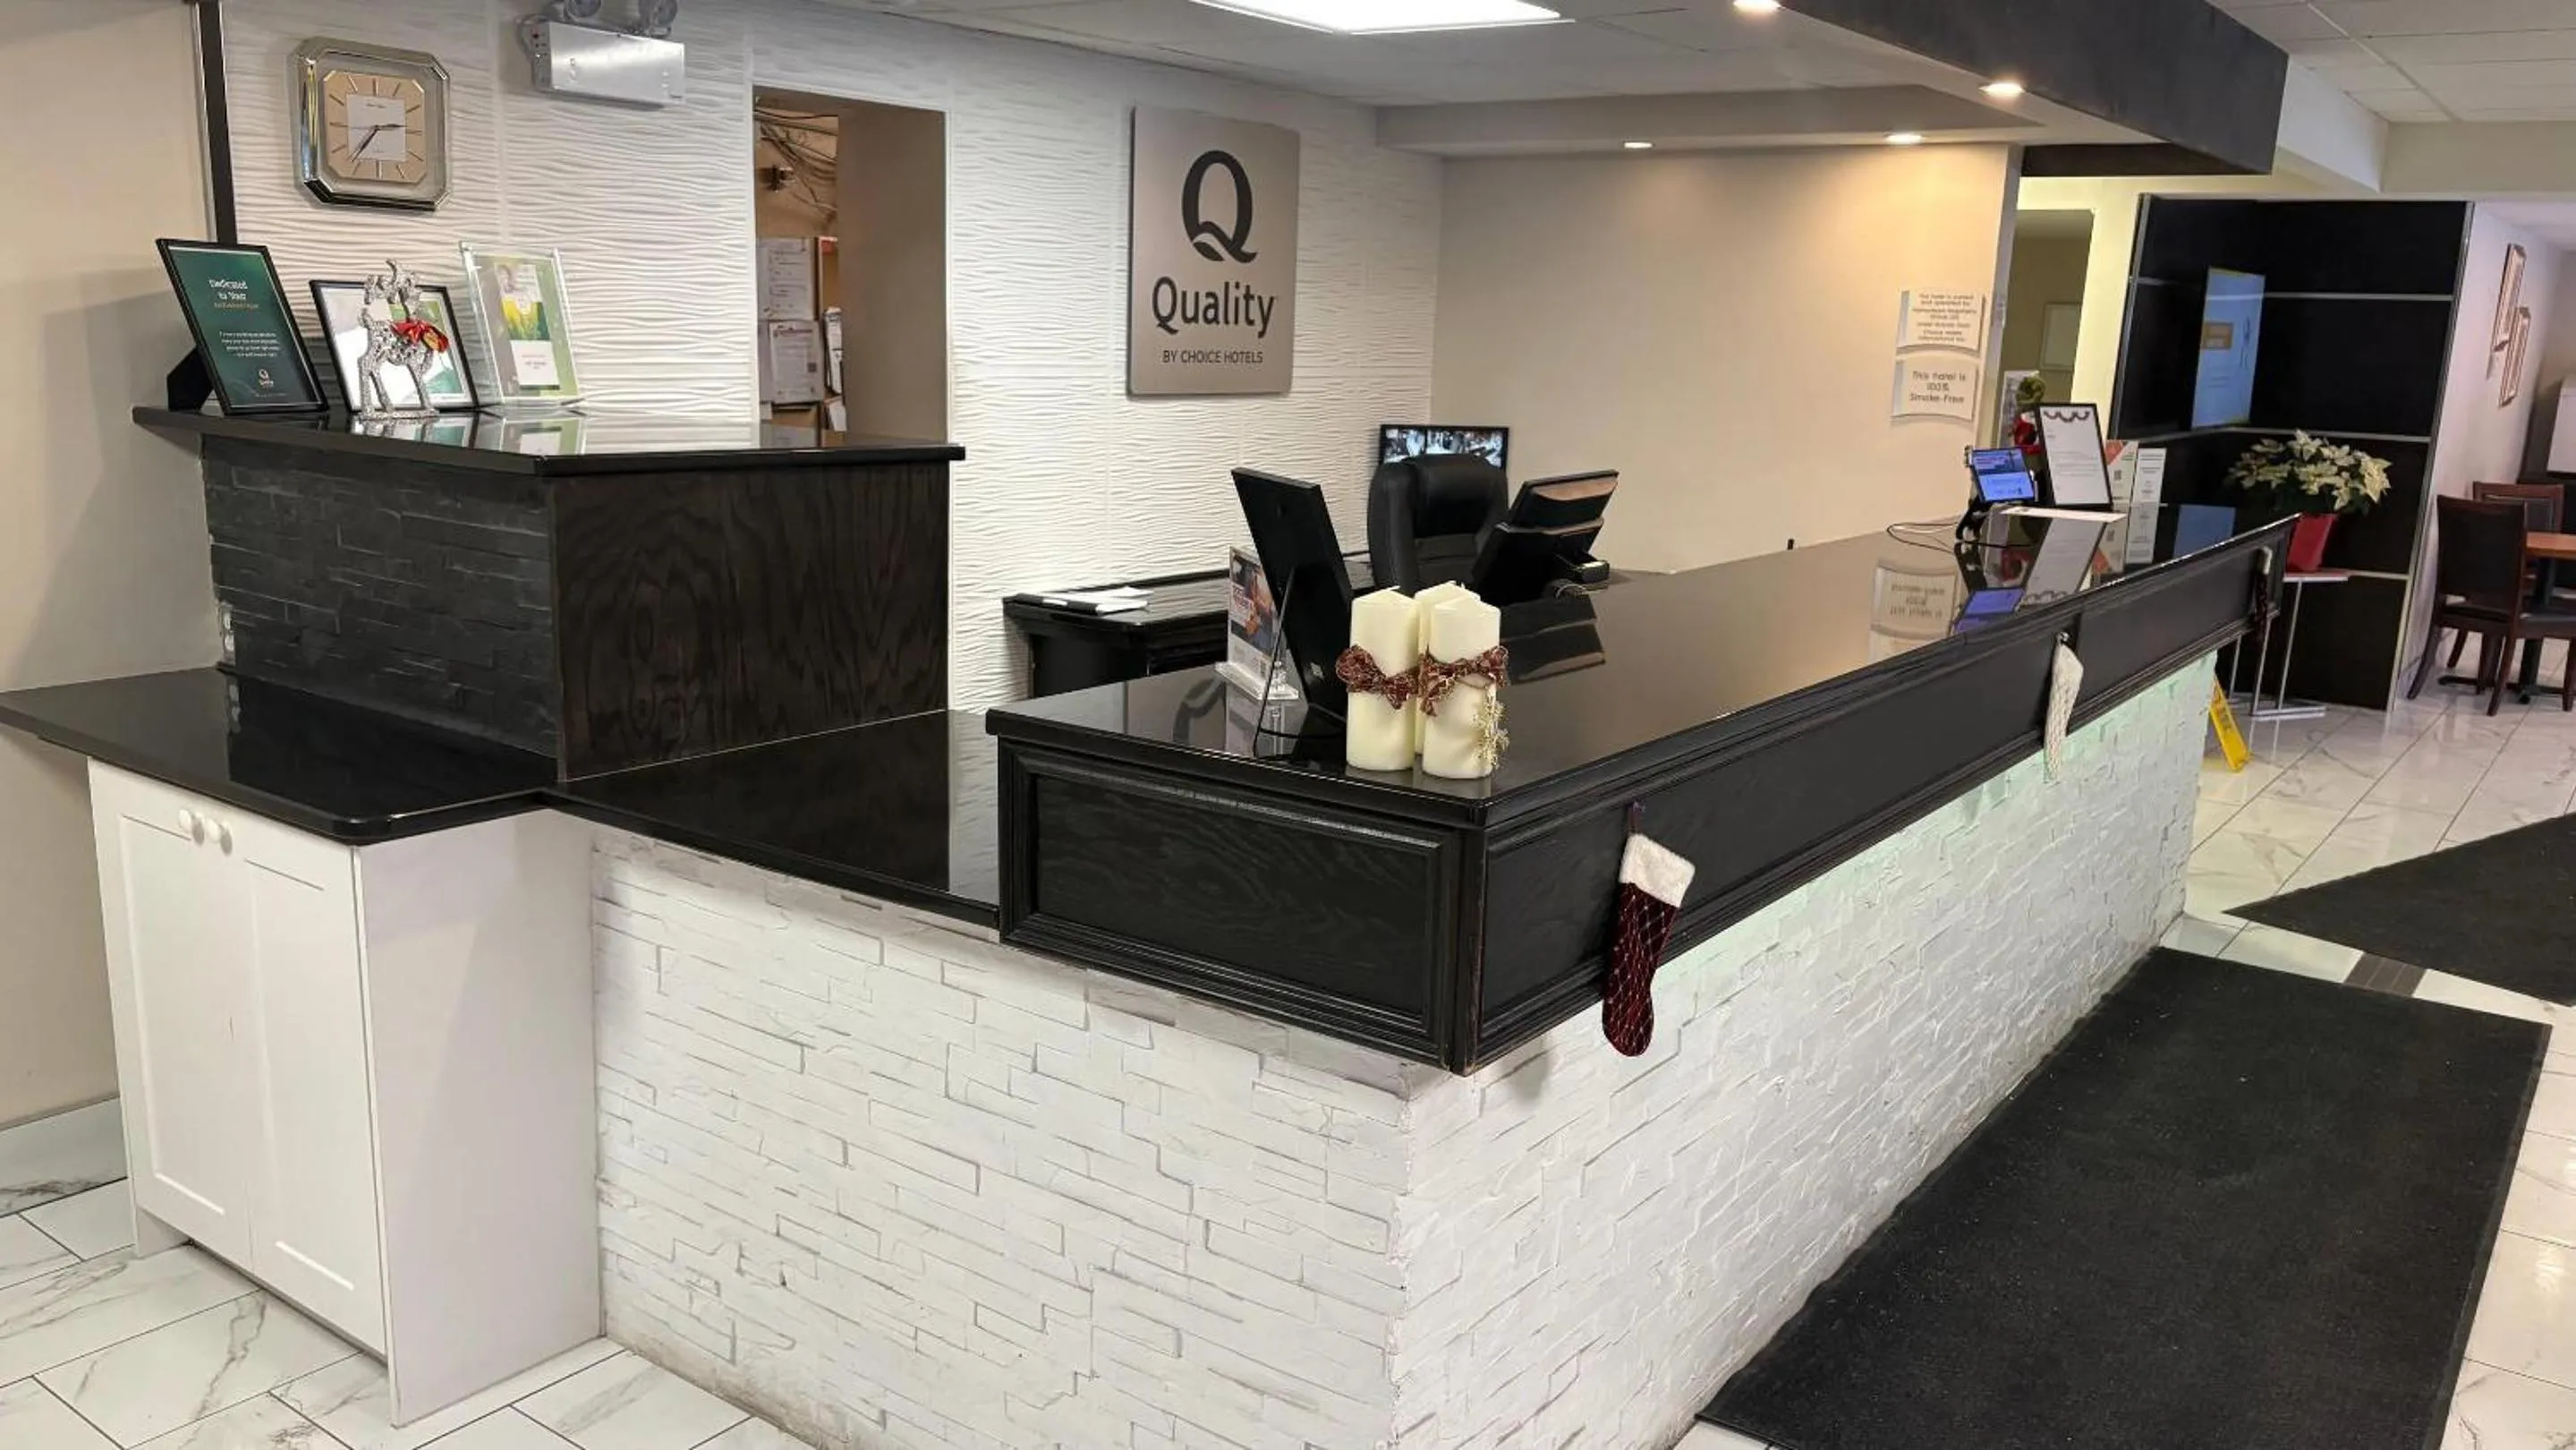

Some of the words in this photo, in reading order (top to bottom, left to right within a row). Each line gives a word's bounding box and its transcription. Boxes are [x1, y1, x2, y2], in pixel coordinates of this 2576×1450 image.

[1152, 276, 1275, 339] Quality
[1162, 350, 1178, 363] BY
[1180, 350, 1222, 363] CHOICE
[1223, 351, 1264, 364] HOTELS
